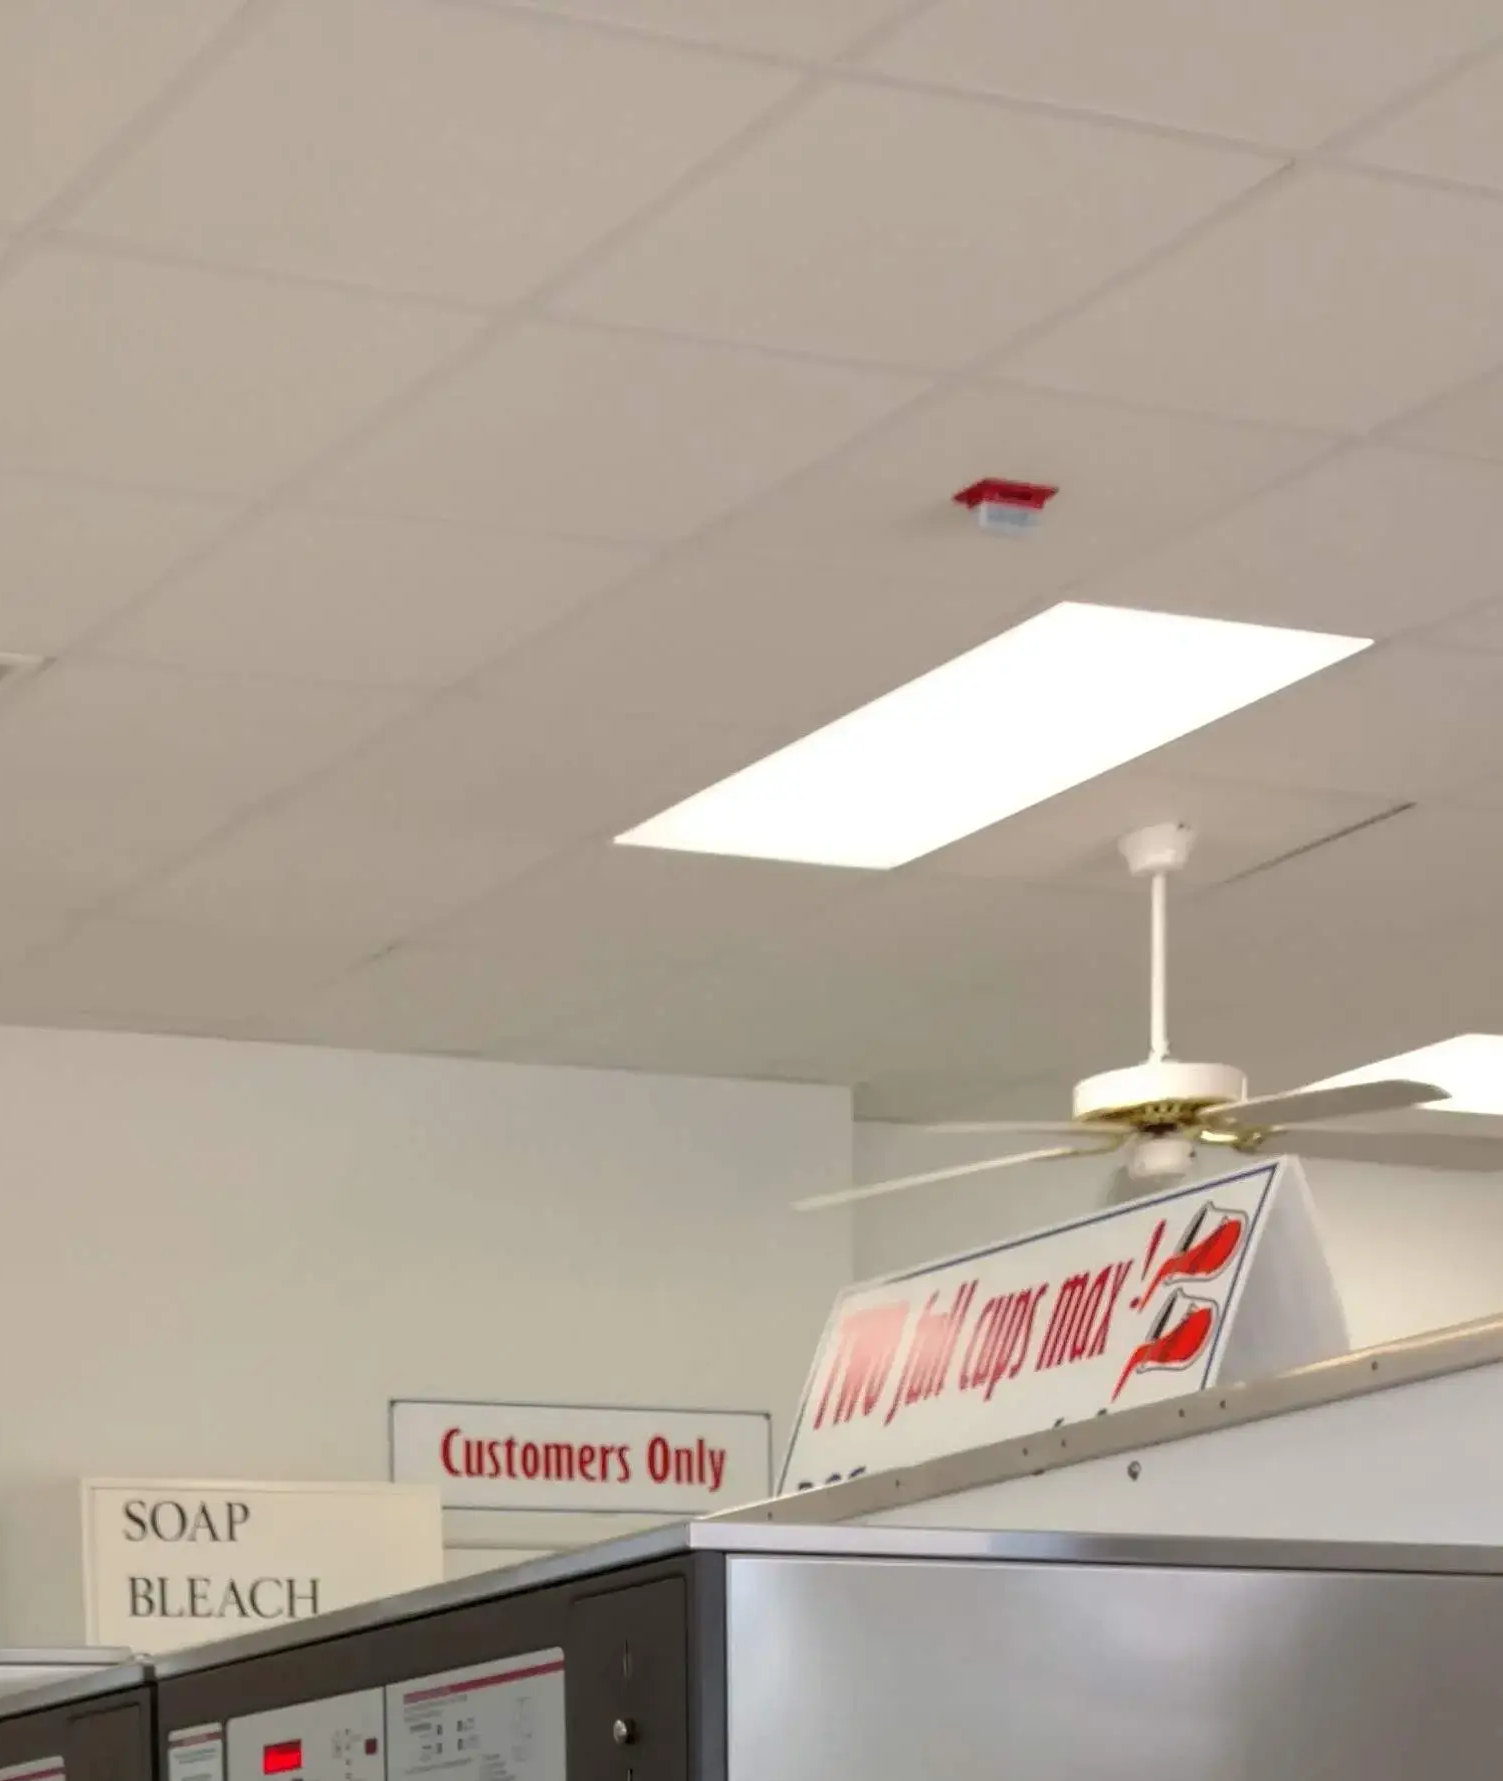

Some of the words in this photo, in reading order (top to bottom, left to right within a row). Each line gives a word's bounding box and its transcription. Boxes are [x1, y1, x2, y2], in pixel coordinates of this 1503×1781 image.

[959, 1283, 1049, 1402] cups
[440, 1427, 632, 1483] Customers
[647, 1434, 726, 1492] Only
[122, 1499, 251, 1543] SOAP
[127, 1576, 321, 1619] BLEACH
